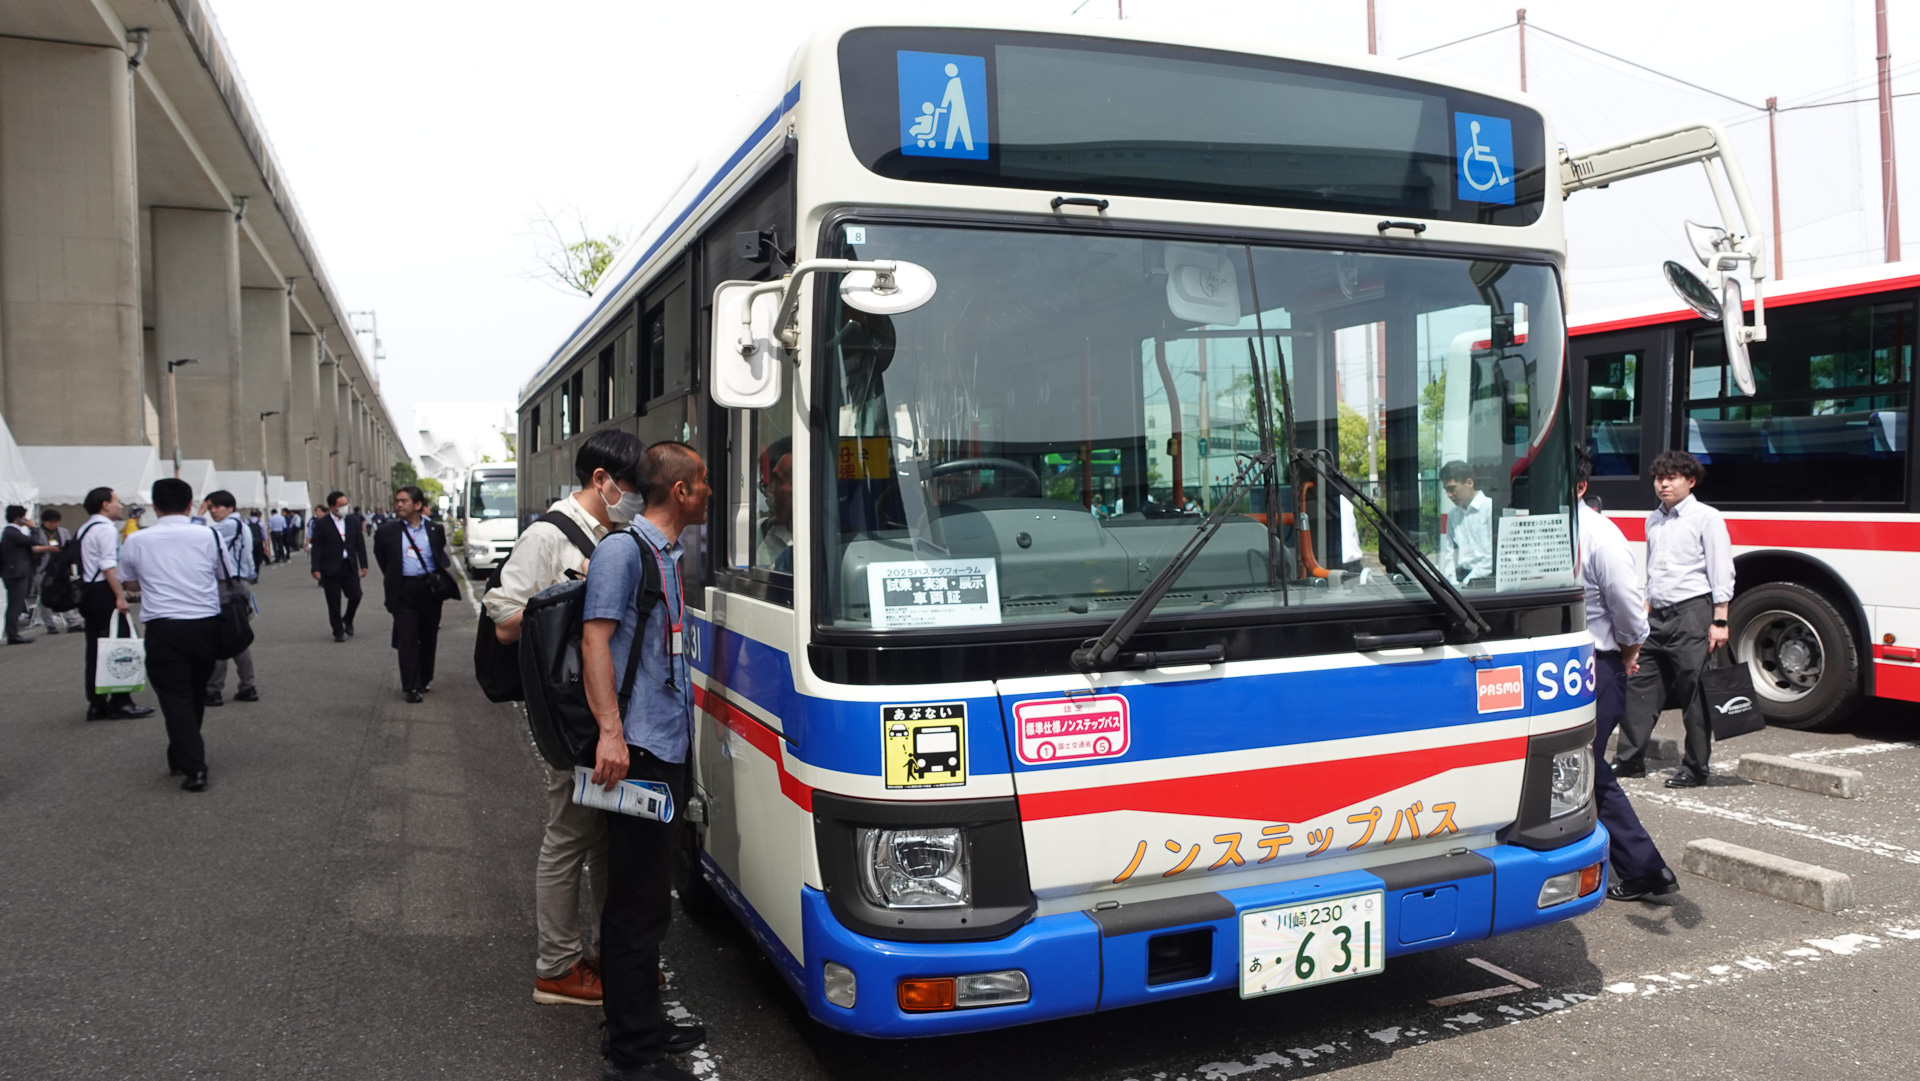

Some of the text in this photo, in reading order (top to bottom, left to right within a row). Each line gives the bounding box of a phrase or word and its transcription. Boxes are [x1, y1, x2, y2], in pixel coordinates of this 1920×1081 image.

[886, 566, 981, 577] 2025バステクフォーラム
[913, 590, 962, 604] 車両証
[1479, 681, 1520, 697] PASMO
[893, 706, 953, 720] あぶない
[1025, 715, 1120, 736] 標準仕様ノンステップバス
[1057, 740, 1092, 750] 国土交通省
[1112, 800, 1459, 884] ノンステップバス
[1249, 956, 1262, 973] あ
